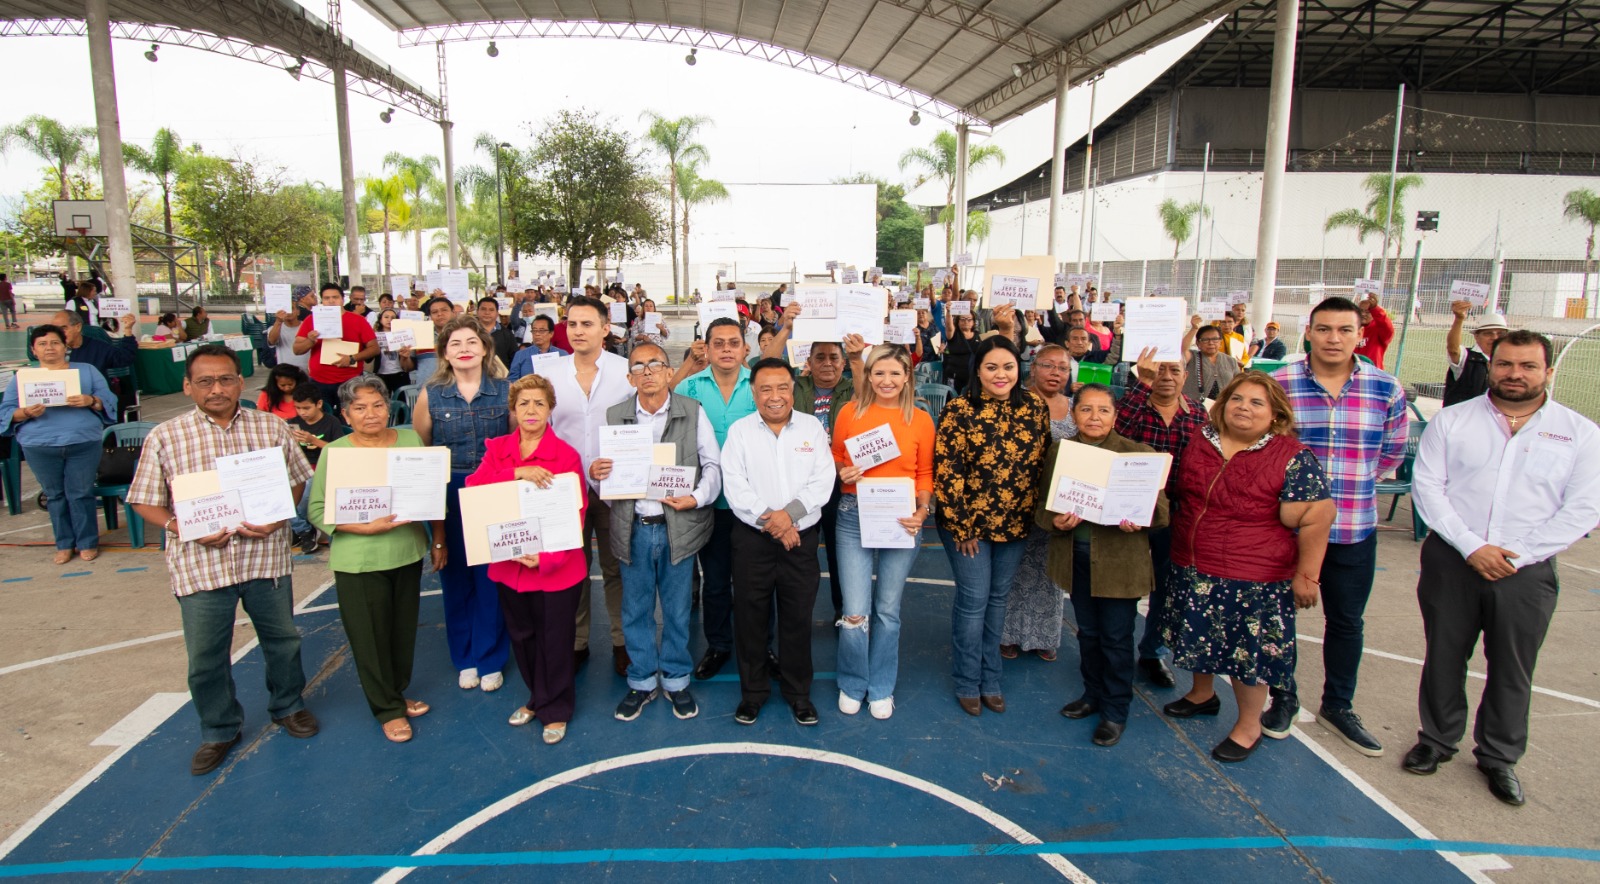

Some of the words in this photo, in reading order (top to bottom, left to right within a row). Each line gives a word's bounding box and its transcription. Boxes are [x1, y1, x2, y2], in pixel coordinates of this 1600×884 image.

[993, 290, 1034, 299] MANZANA
[854, 440, 893, 459] MANZANA
[859, 441, 874, 453] JEFE
[875, 437, 885, 445] DE
[1068, 490, 1085, 499] JEFE
[340, 503, 388, 511] MANZANA
[1059, 493, 1103, 511] MANZANA
[184, 508, 239, 526] MANZANA
[192, 507, 212, 518] JEFE
[216, 504, 229, 513] DE
[493, 535, 539, 548] MANZANA
[500, 532, 517, 540] JEFE
